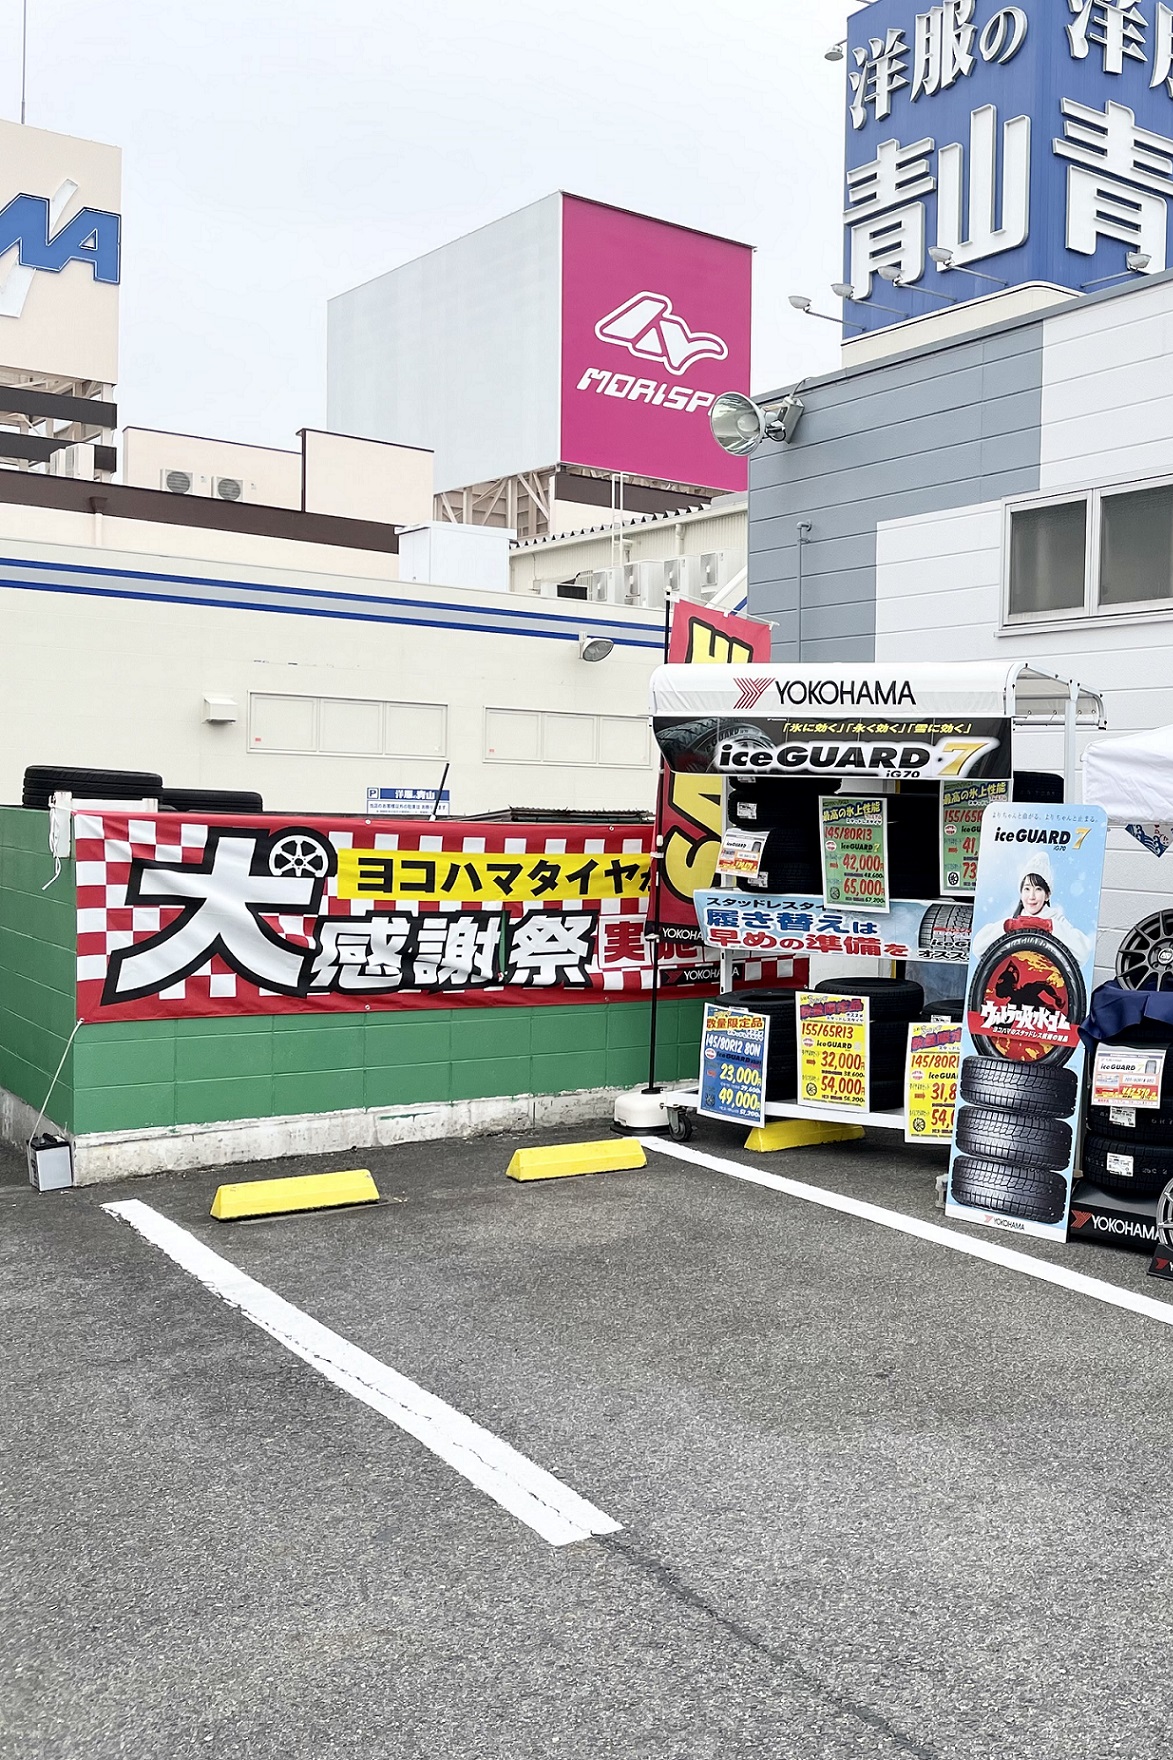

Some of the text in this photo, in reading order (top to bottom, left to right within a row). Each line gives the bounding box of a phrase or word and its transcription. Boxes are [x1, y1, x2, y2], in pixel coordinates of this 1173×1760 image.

[848, 0, 1028, 130] 洋服の
[843, 104, 1031, 300] 青山
[577, 367, 715, 416] MORISP
[775, 679, 917, 707] YOKOHAMA
[719, 742, 990, 776] iceGUARD 7
[824, 826, 873, 842] 145/80R13
[994, 826, 1092, 850] iceGUARD 7
[707, 896, 841, 912] スタッドレスタイ
[706, 908, 878, 934] 履き替えは
[708, 928, 909, 957] 早めの準備を
[706, 1033, 743, 1053] 145/80R12
[801, 1022, 854, 1039] 155/65R13
[994, 1217, 1025, 1231] YOKOHAMA
